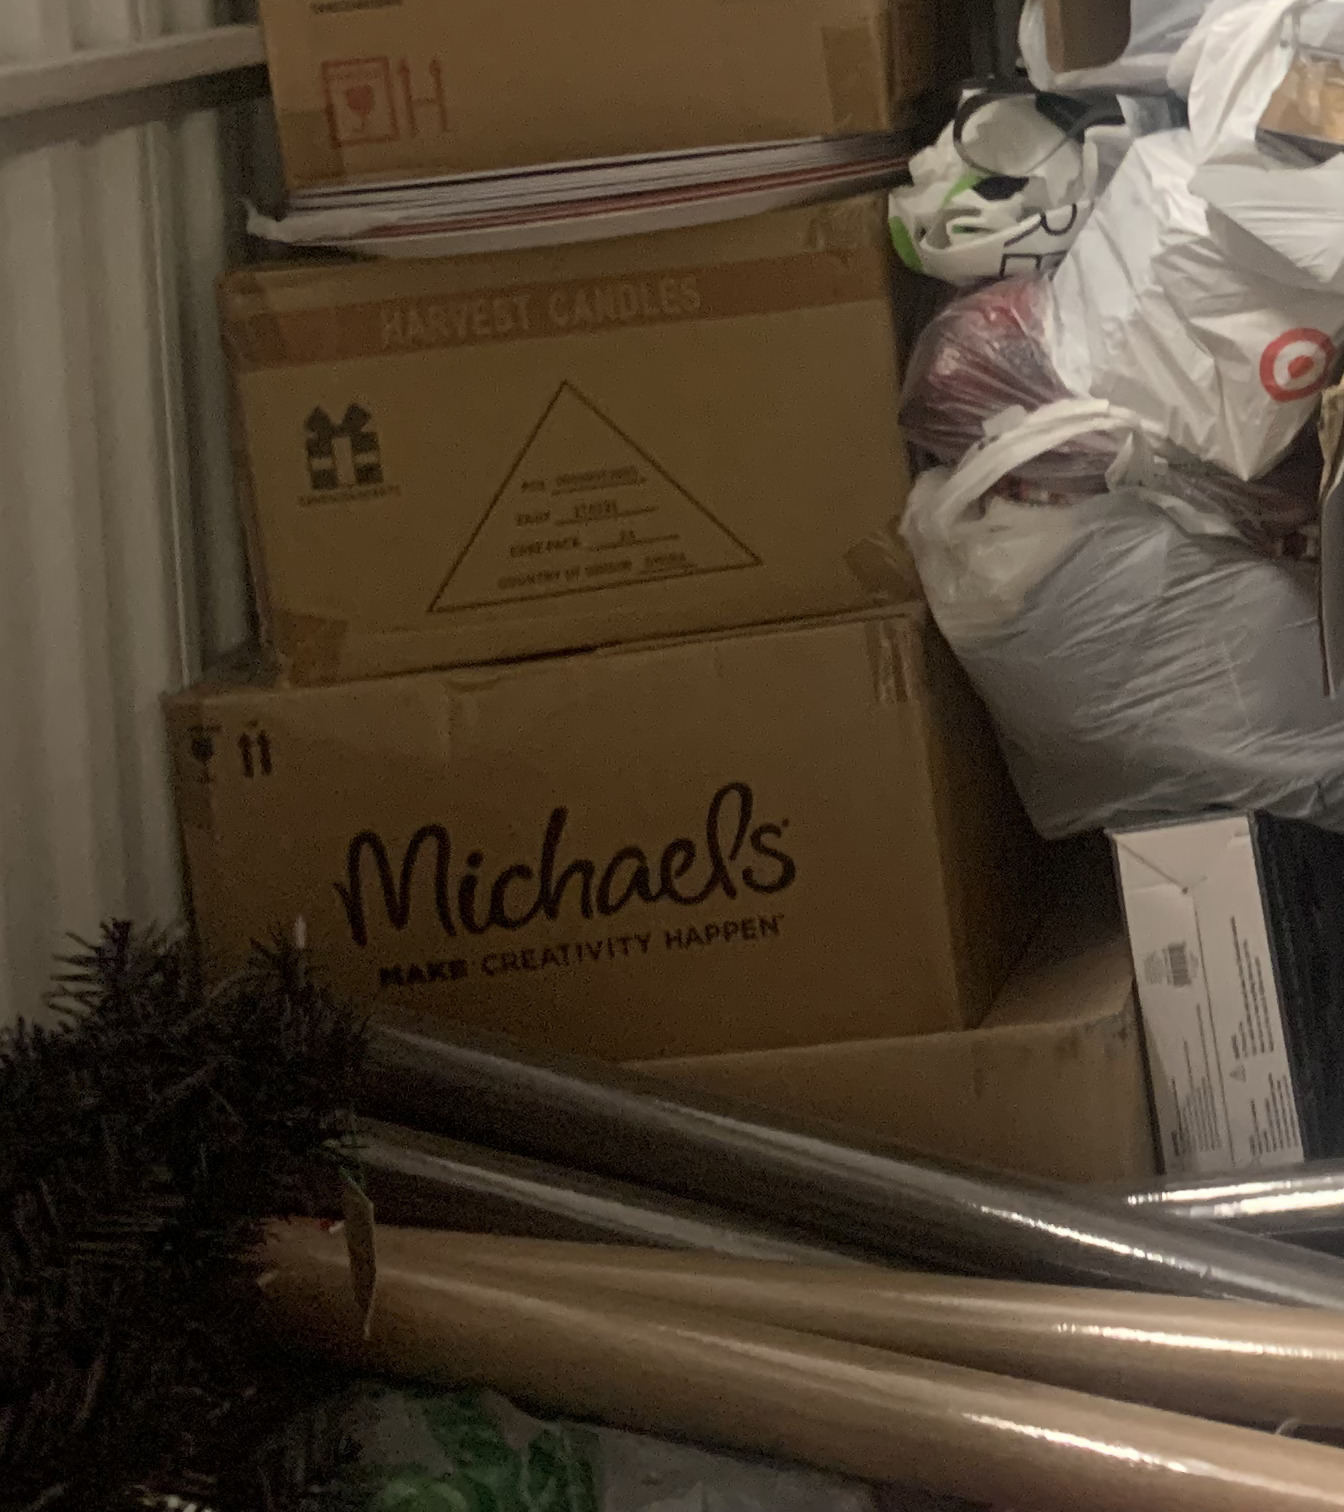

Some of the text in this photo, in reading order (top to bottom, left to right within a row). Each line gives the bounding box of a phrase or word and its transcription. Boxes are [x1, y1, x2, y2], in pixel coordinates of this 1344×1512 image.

[379, 276, 702, 349] HARVEST CANDLES
[332, 781, 797, 948] Michaels
[379, 915, 781, 988] MAKE CREATIVITY HAPPEN
